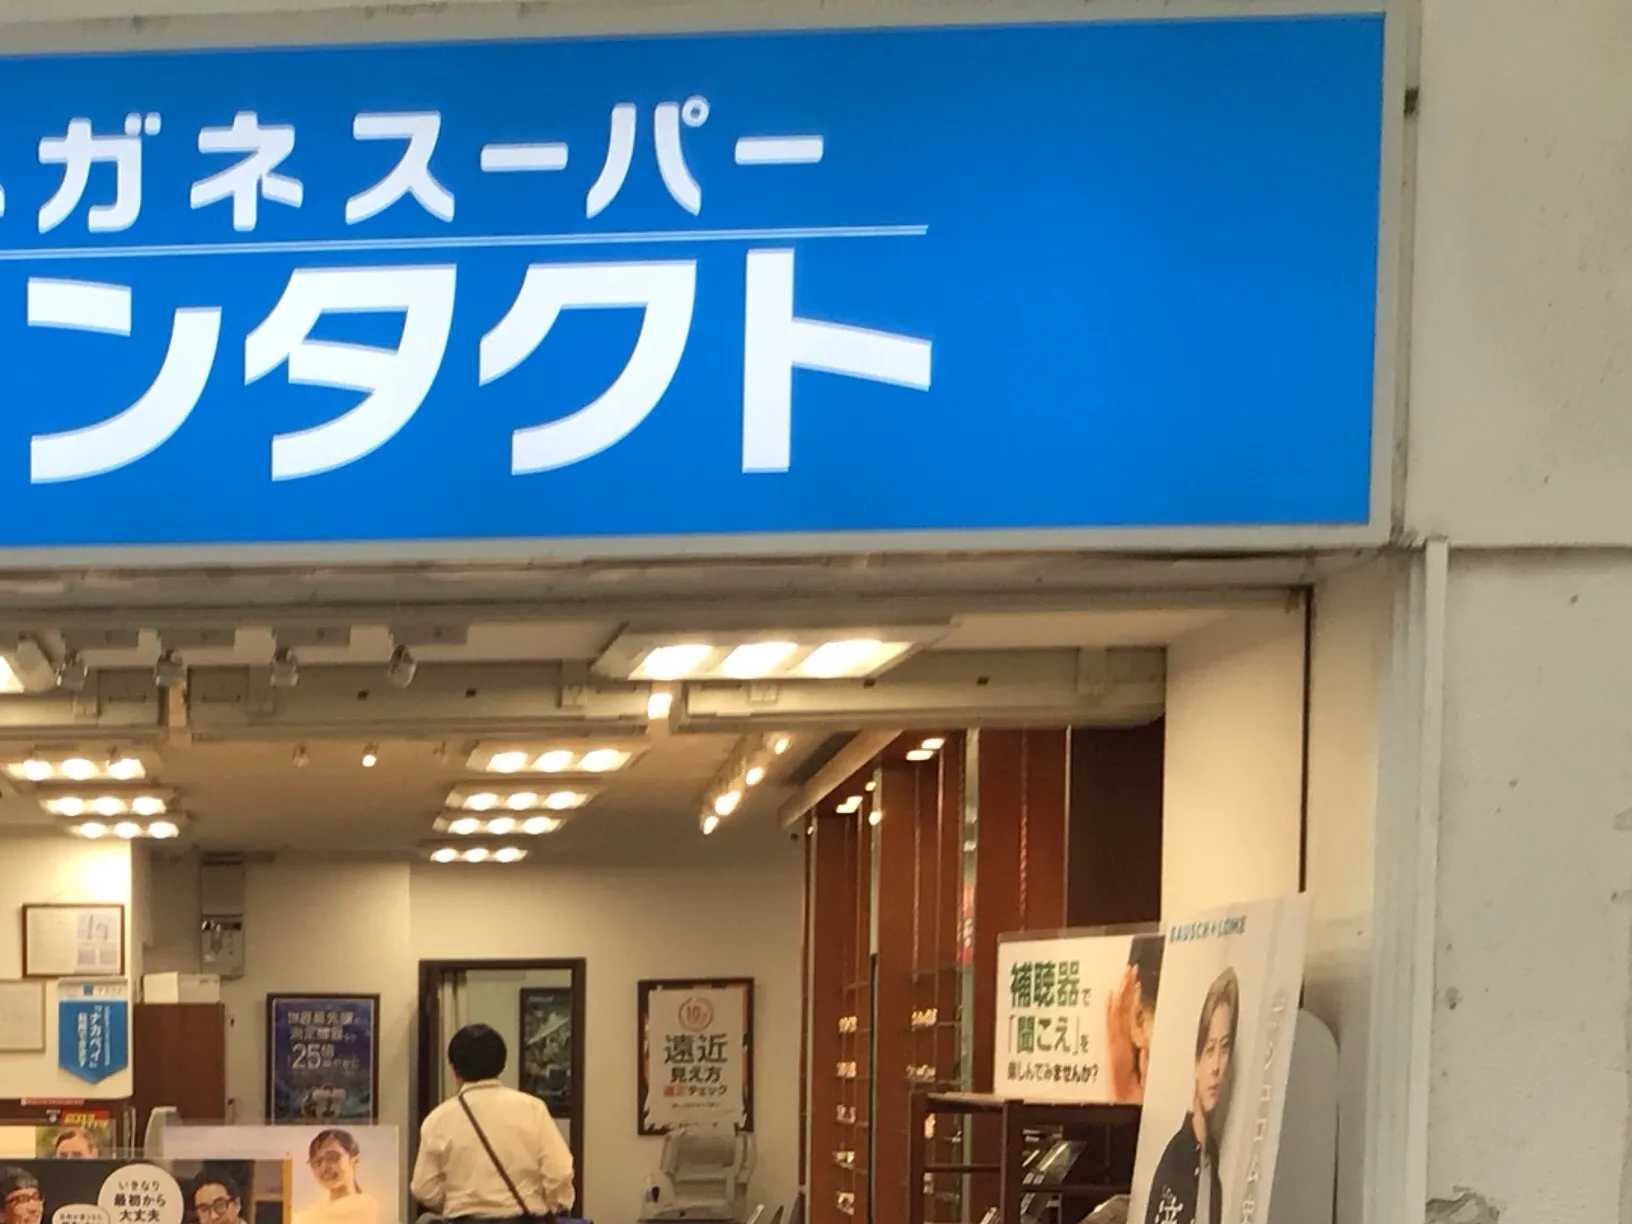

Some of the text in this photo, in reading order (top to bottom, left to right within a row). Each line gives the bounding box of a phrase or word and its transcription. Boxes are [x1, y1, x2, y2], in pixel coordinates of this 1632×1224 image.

[1010, 960, 1091, 1009] 補聴器で
[1008, 1015, 1090, 1056] 「聞こえ」を
[664, 1033, 728, 1064] 遠近
[669, 1066, 722, 1084] 見え方
[118, 1179, 161, 1192] いきなり
[114, 1194, 167, 1208] 最初から
[119, 1210, 161, 1223] 大丈夫
